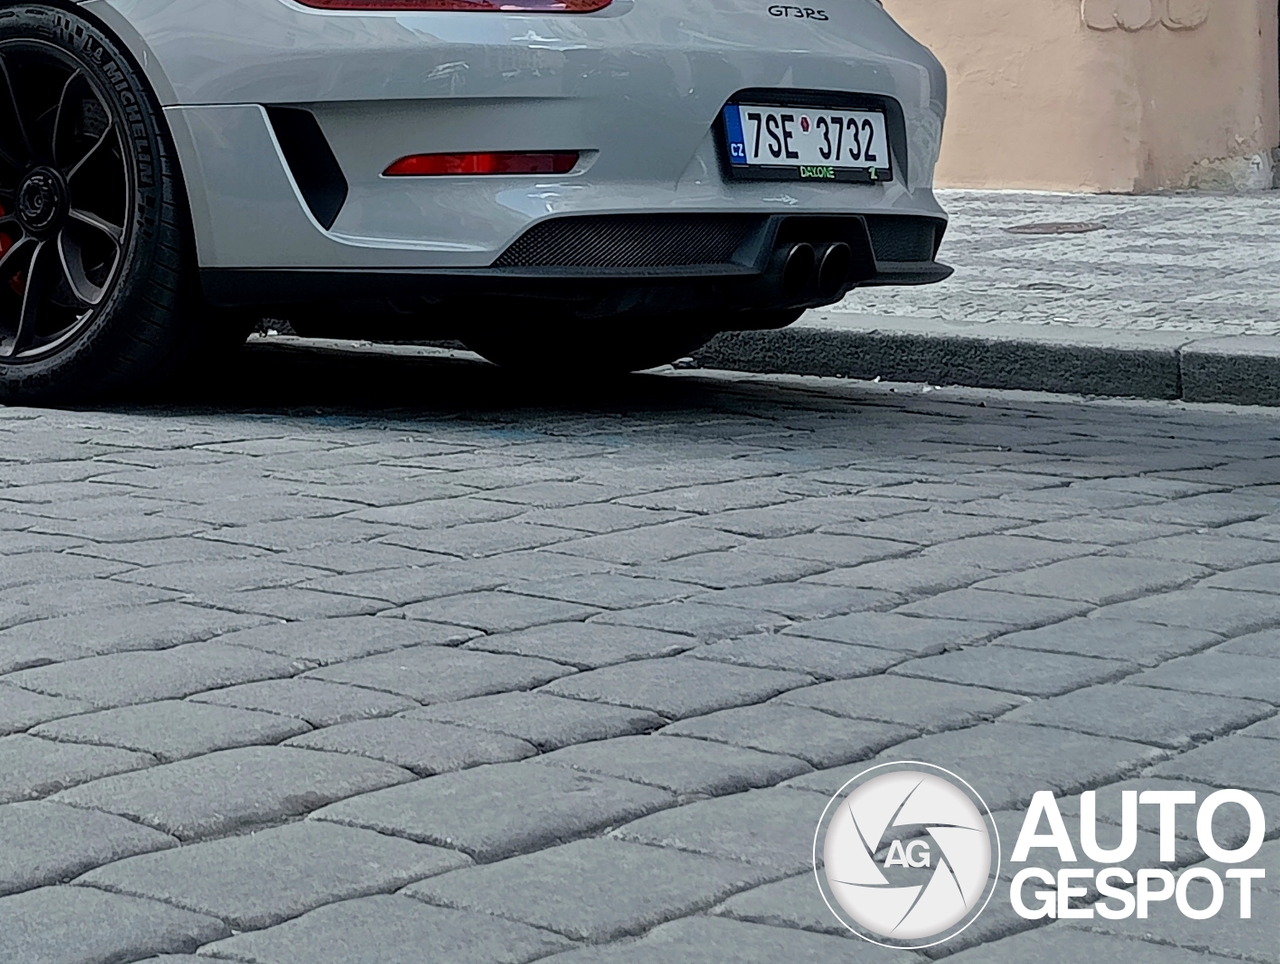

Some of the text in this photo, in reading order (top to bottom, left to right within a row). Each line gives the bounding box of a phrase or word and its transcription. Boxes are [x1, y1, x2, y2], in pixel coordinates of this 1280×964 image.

[102, 60, 154, 186] MICHELIN
[747, 112, 877, 162] 7SE 3732
[730, 143, 744, 157] CZ
